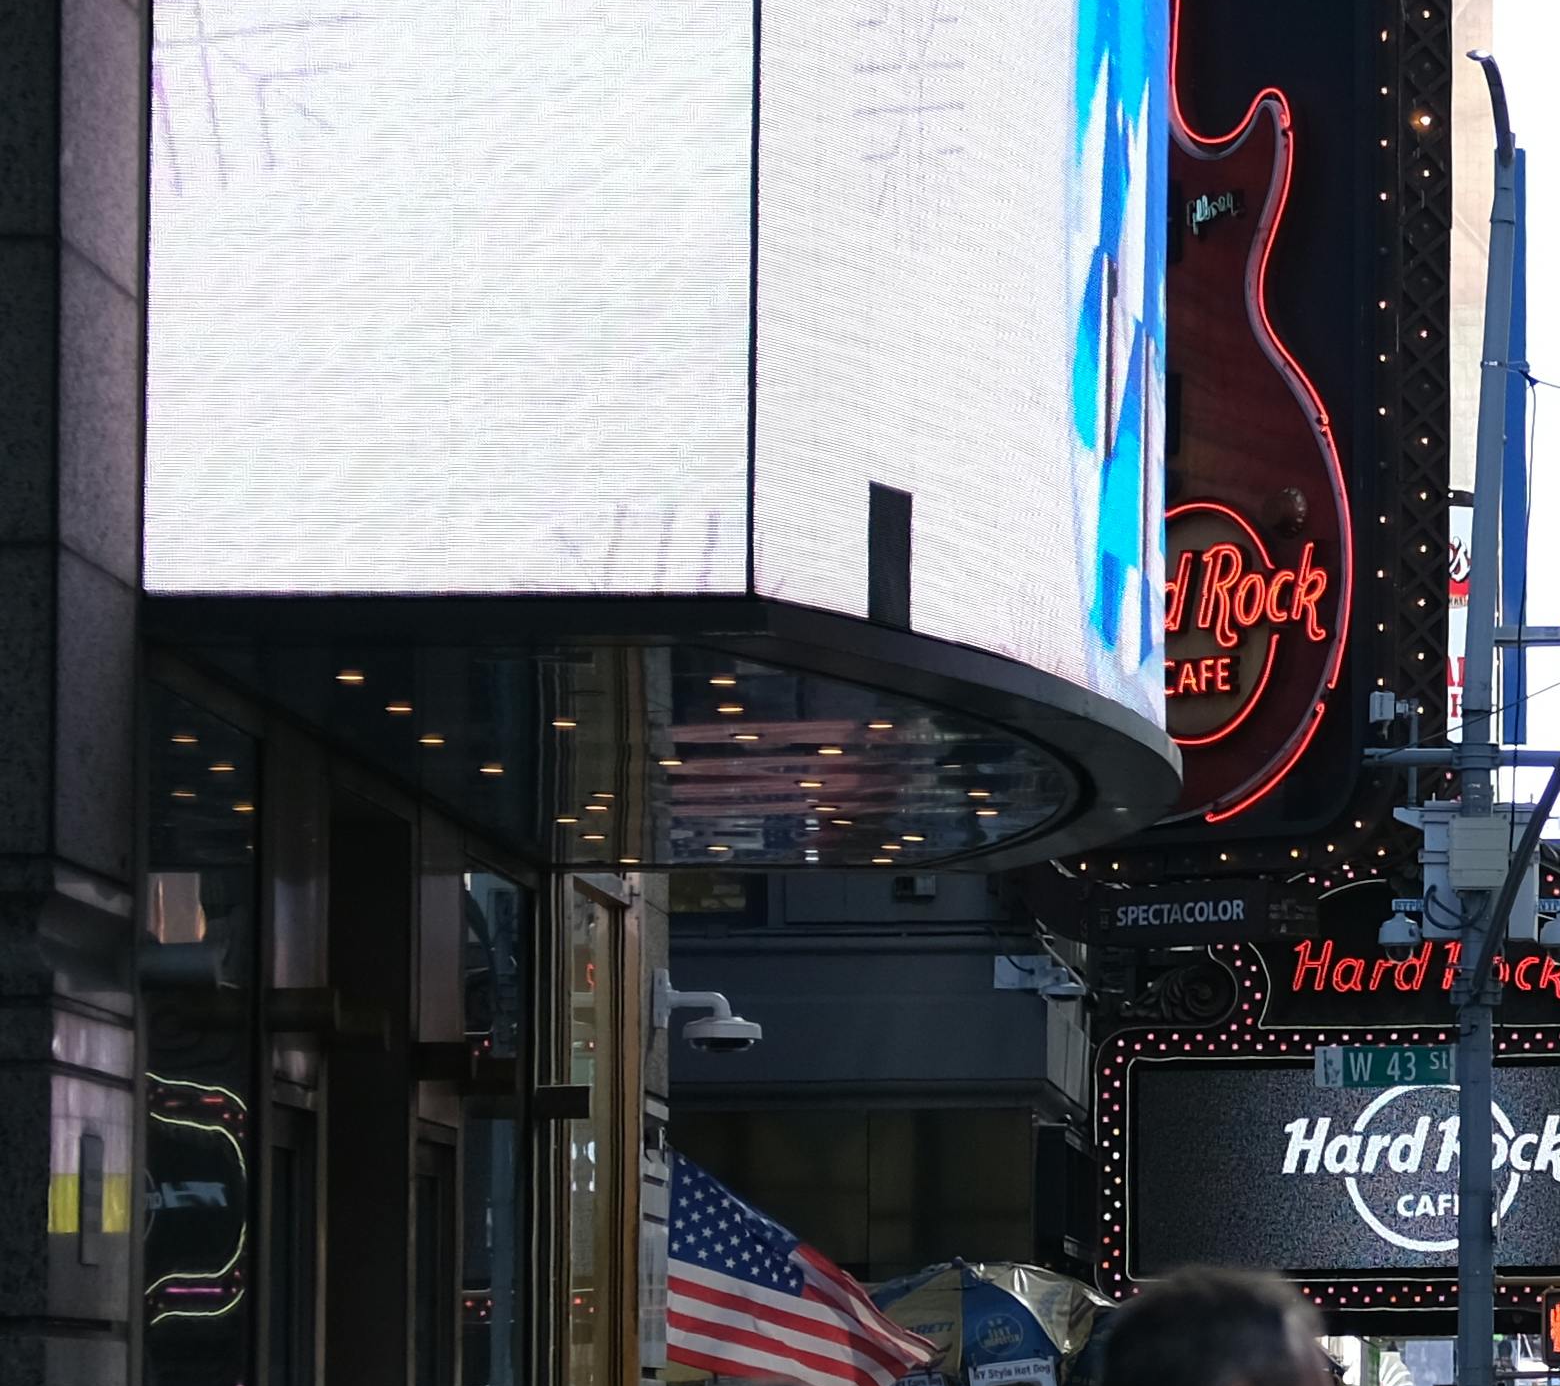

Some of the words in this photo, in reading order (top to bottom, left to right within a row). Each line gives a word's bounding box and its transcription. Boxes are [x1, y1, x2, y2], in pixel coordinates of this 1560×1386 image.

[1198, 540, 1327, 648] Rock
[1116, 900, 1245, 927] SPECTACOLOR
[1292, 939, 1432, 993] Hard
[1349, 1053, 1374, 1083] W
[1387, 1051, 1417, 1082] 43
[1429, 1050, 1449, 1071] St
[1281, 1116, 1432, 1175] Hard
[988, 1368, 1013, 1380] Style
[1014, 1366, 1031, 1376] Hot
[1032, 1363, 1051, 1377] Dog
